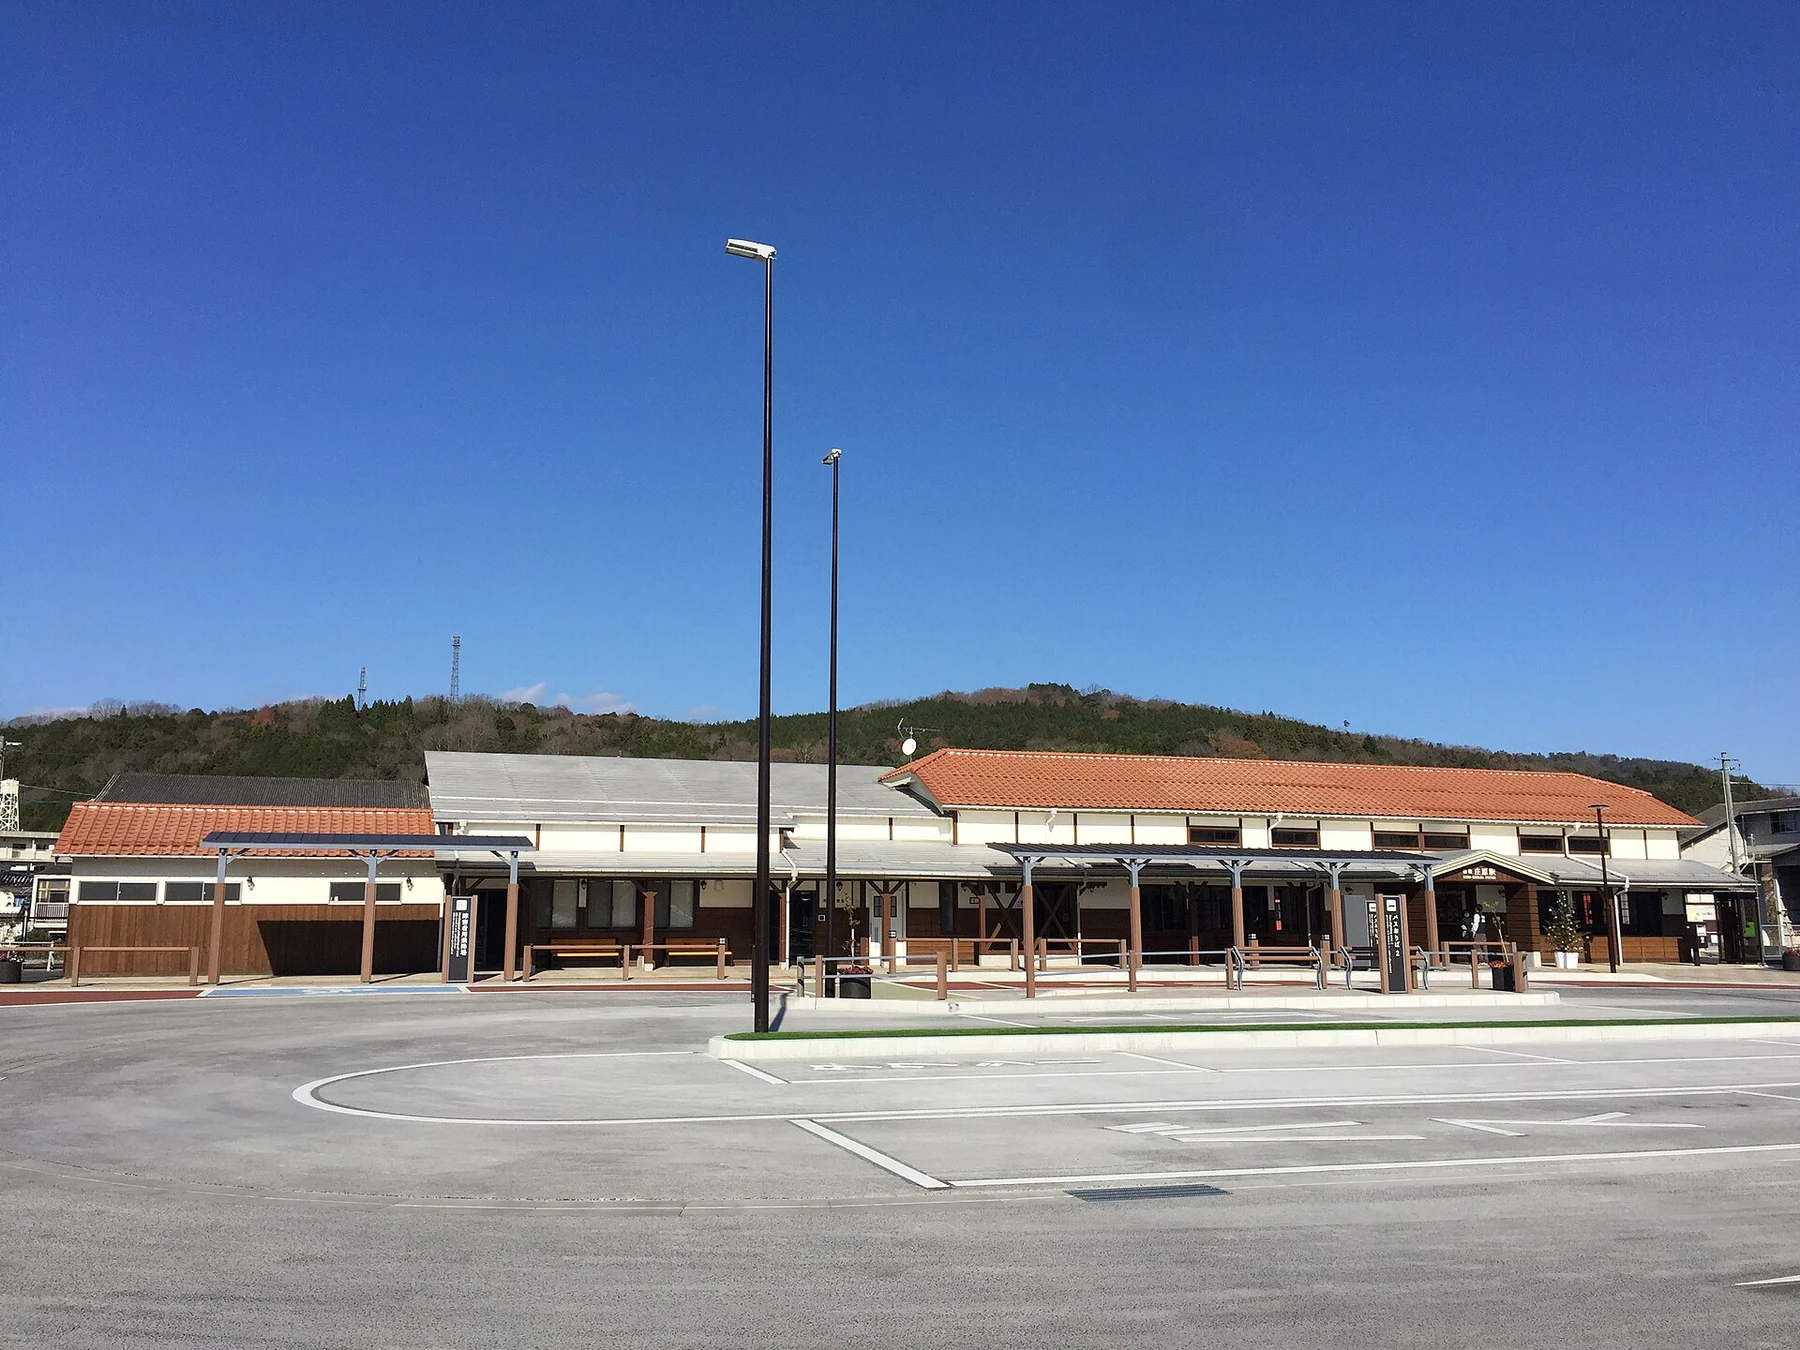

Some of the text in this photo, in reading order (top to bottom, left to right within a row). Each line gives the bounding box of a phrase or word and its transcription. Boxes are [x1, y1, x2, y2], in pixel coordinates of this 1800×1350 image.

[809, 1059, 1102, 1071] タクシー
[1102, 1111, 1706, 1143] バス
